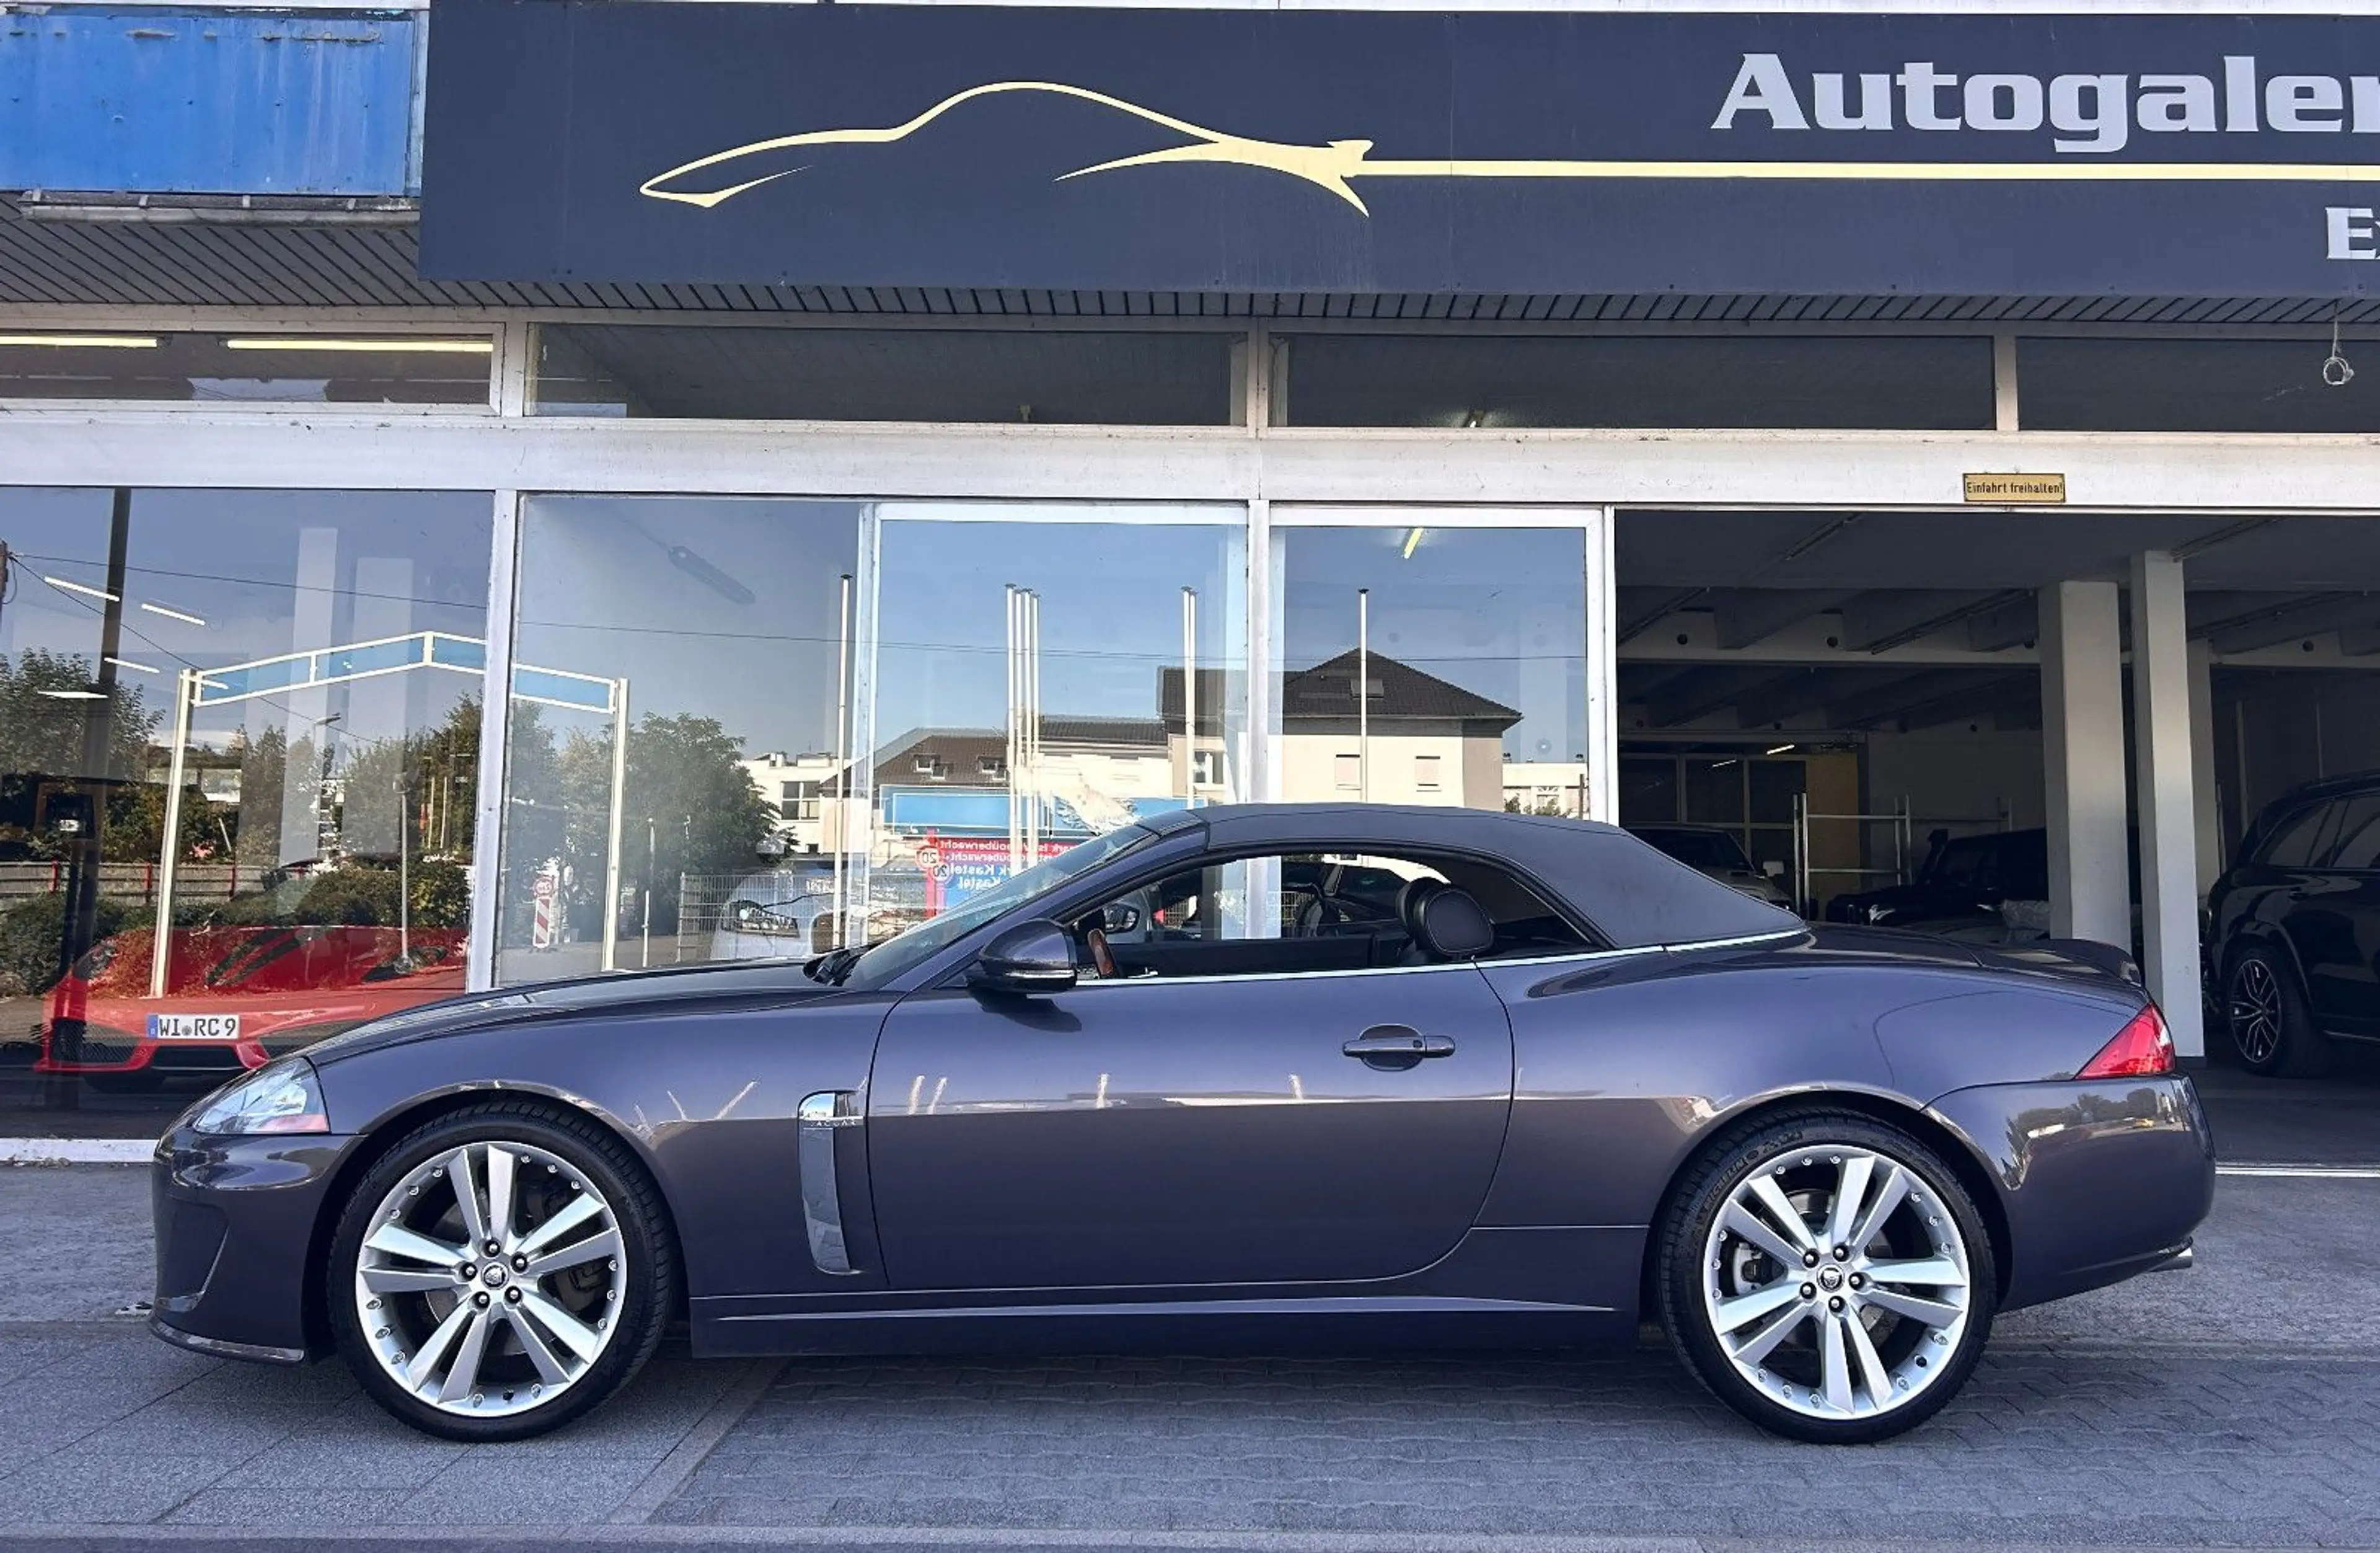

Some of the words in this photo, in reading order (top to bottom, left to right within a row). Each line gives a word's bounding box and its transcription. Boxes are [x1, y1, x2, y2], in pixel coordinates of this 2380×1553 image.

[2325, 207, 2380, 260] E
[1966, 482, 2007, 493] Einfahrt
[2011, 482, 2064, 493] freihalten!
[159, 1019, 180, 1036] WI
[194, 1019, 219, 1036] RC
[224, 1018, 237, 1036] 9
